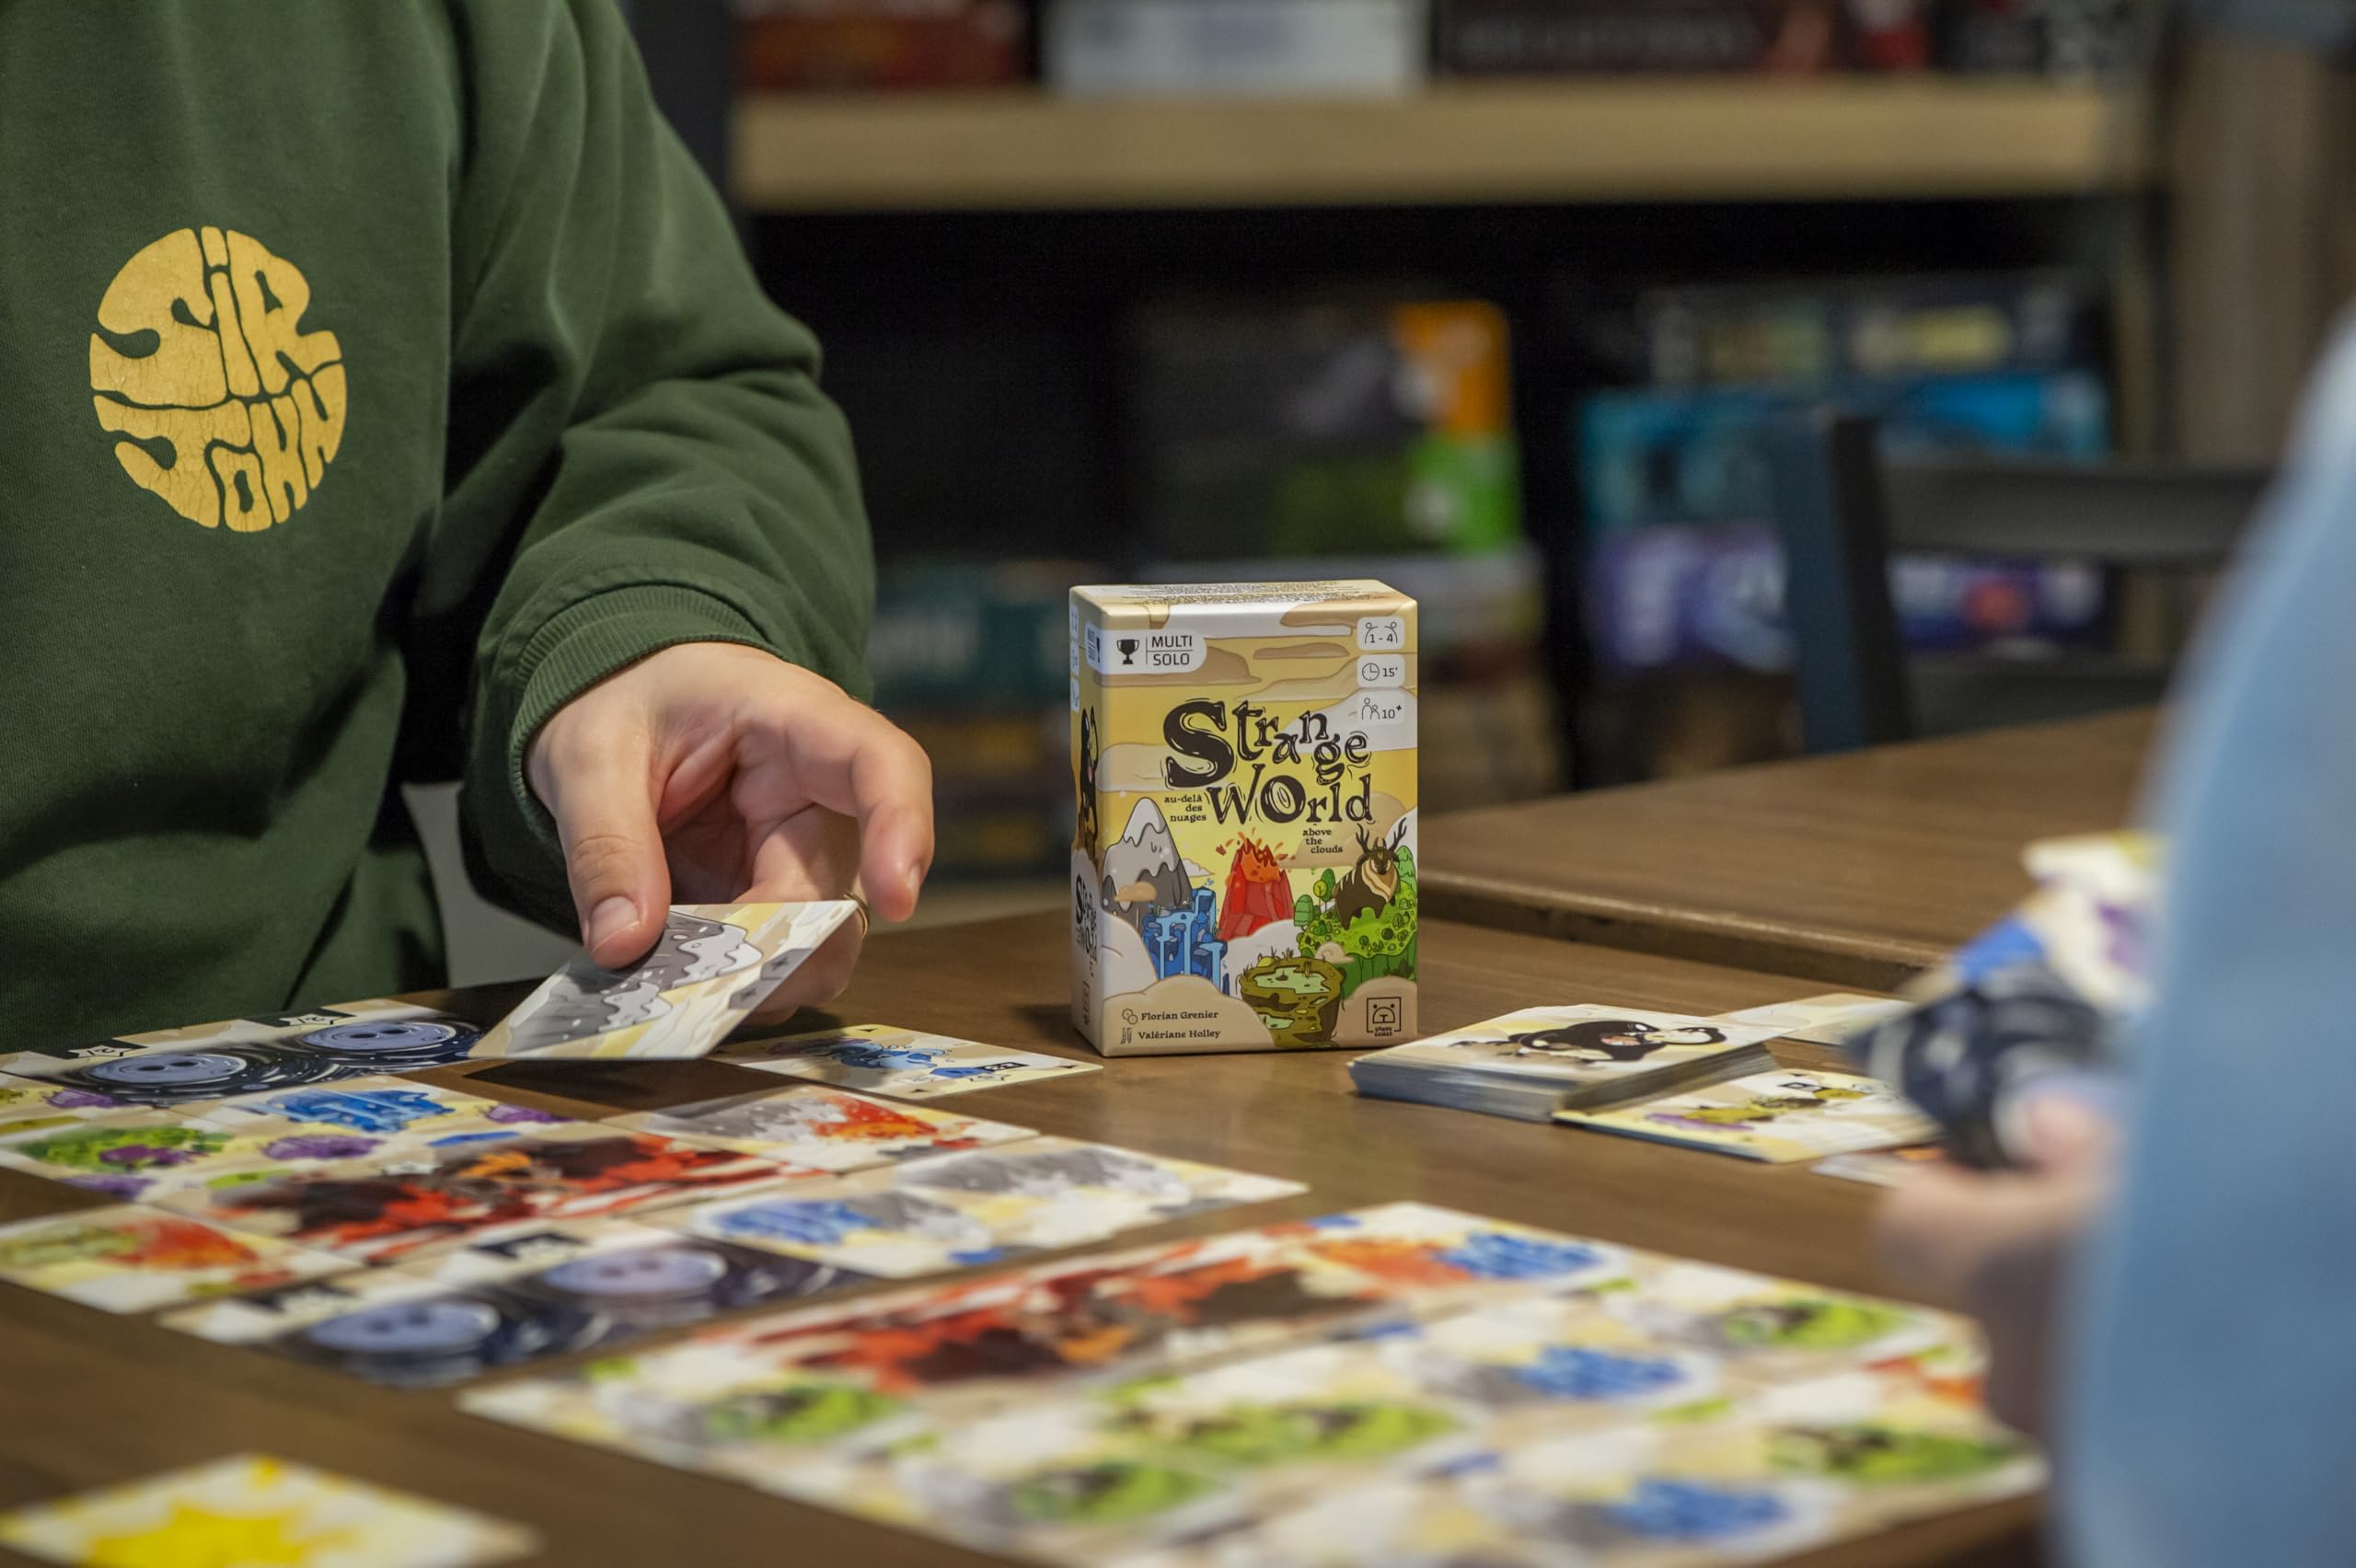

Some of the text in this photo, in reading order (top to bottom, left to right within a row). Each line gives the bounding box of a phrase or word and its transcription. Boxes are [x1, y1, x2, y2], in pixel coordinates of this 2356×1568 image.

[1151, 635, 1193, 648] MULTI
[1152, 652, 1190, 666] SOLO
[1162, 699, 1371, 788] Strange
[1185, 803, 1203, 813] des
[1170, 814, 1207, 824] nuages
[1302, 827, 1333, 836] above
[1305, 837, 1322, 846] the
[1311, 845, 1344, 854] clouds
[1141, 1010, 1218, 1020] Florian Grenier
[1138, 1029, 1221, 1040] Valériane Holley
